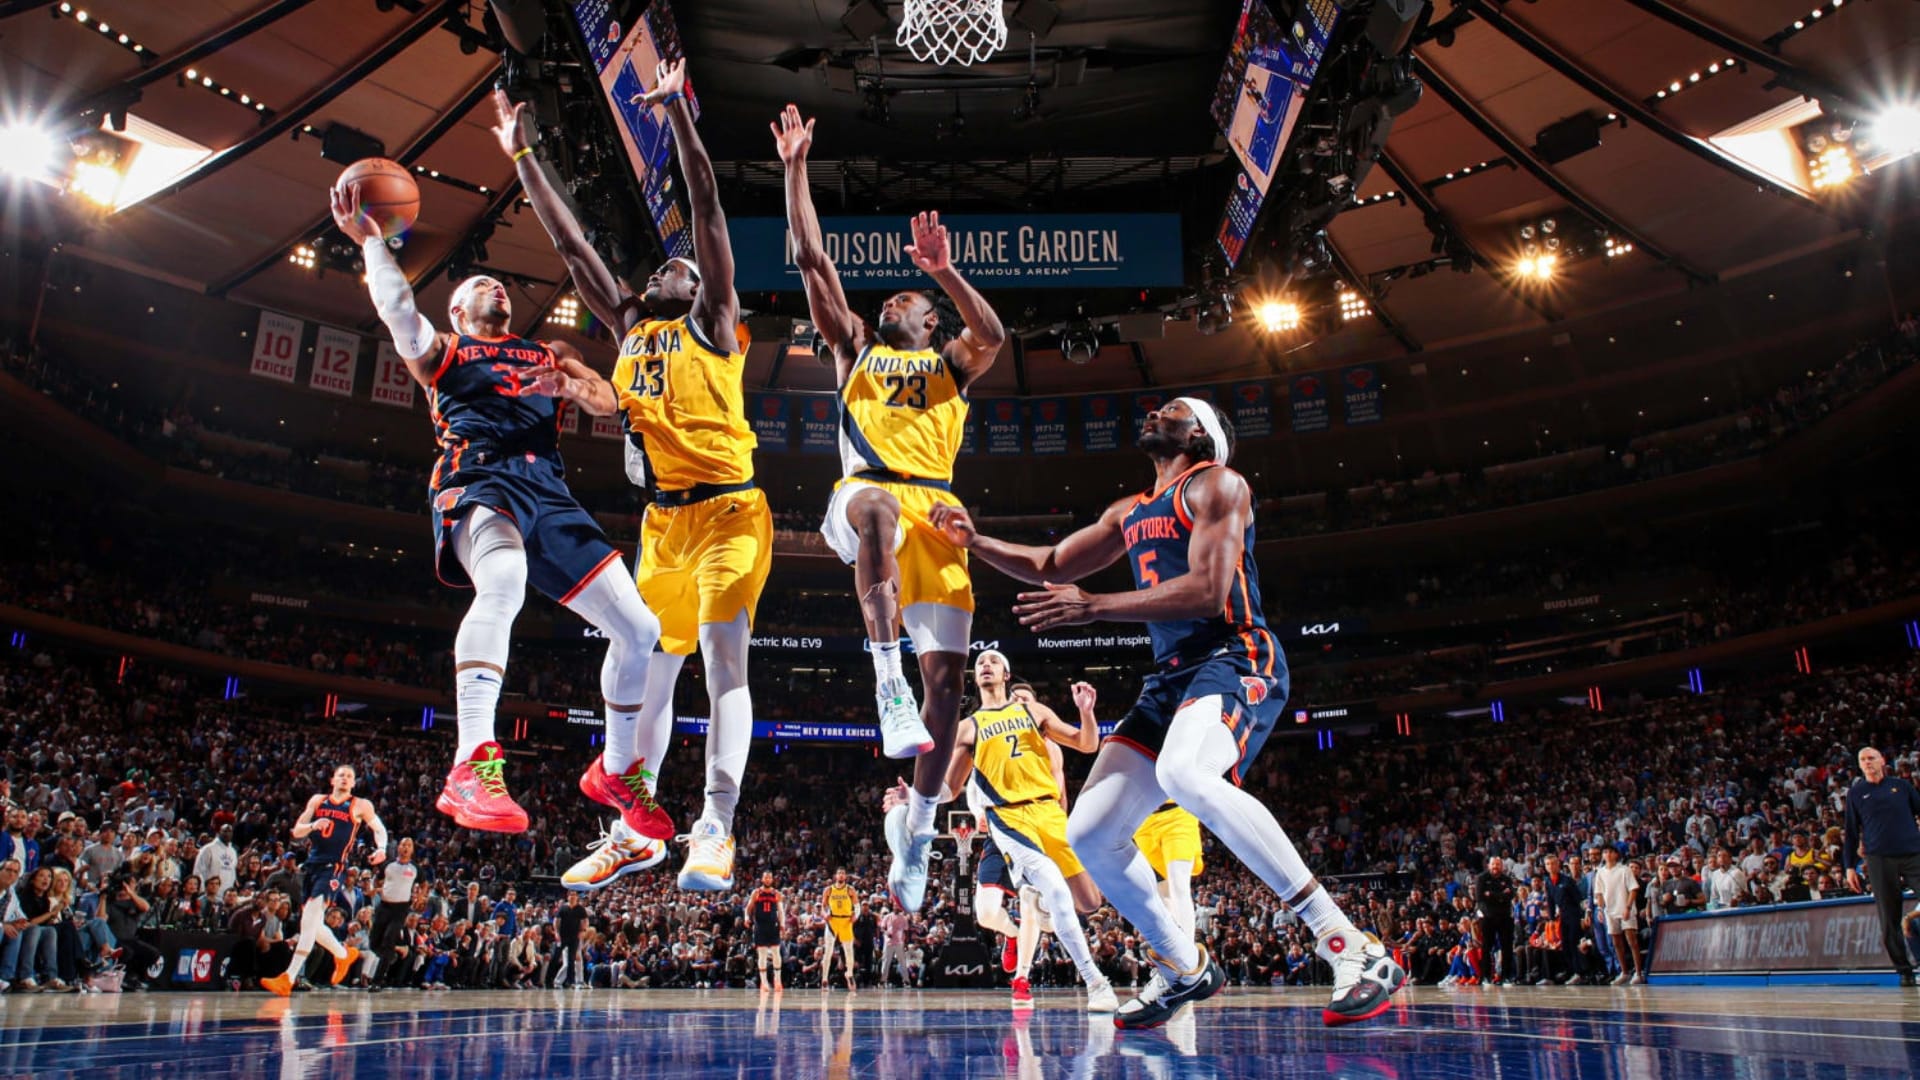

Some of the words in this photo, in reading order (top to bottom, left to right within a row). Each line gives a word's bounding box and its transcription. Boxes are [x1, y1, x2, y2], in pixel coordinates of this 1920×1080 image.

[785, 228, 901, 265] DISON
[947, 231, 1009, 264] UARE
[969, 268, 1021, 276] FAMOUS
[262, 331, 293, 361] 10
[457, 347, 499, 365] NEW
[502, 347, 551, 368] YORK
[254, 359, 294, 379] KNICKS
[321, 346, 351, 374] 12
[867, 356, 945, 378] INDANA
[314, 373, 351, 392] KNICKS
[381, 360, 410, 387] 15
[491, 363, 522, 398] 3
[630, 360, 665, 397] 43
[374, 387, 412, 404] KNICKS
[885, 375, 926, 409] 23
[594, 421, 622, 434] KNICK
[1124, 521, 1140, 551] EW
[1141, 516, 1180, 540] YORK
[1138, 549, 1159, 588] 5
[251, 592, 275, 603] BUD
[276, 595, 309, 608] LIGHT
[782, 637, 798, 648] Kia
[801, 637, 823, 648] EV9
[1038, 638, 1090, 648] Movement
[1094, 636, 1114, 647] that
[802, 727, 819, 736] NEW
[821, 728, 843, 737] YORK
[845, 728, 876, 737] KNICKS
[979, 716, 1034, 741] INDIANA
[1006, 735, 1022, 759] 2
[1823, 917, 1854, 956] GET
[1854, 914, 1882, 955] THE
